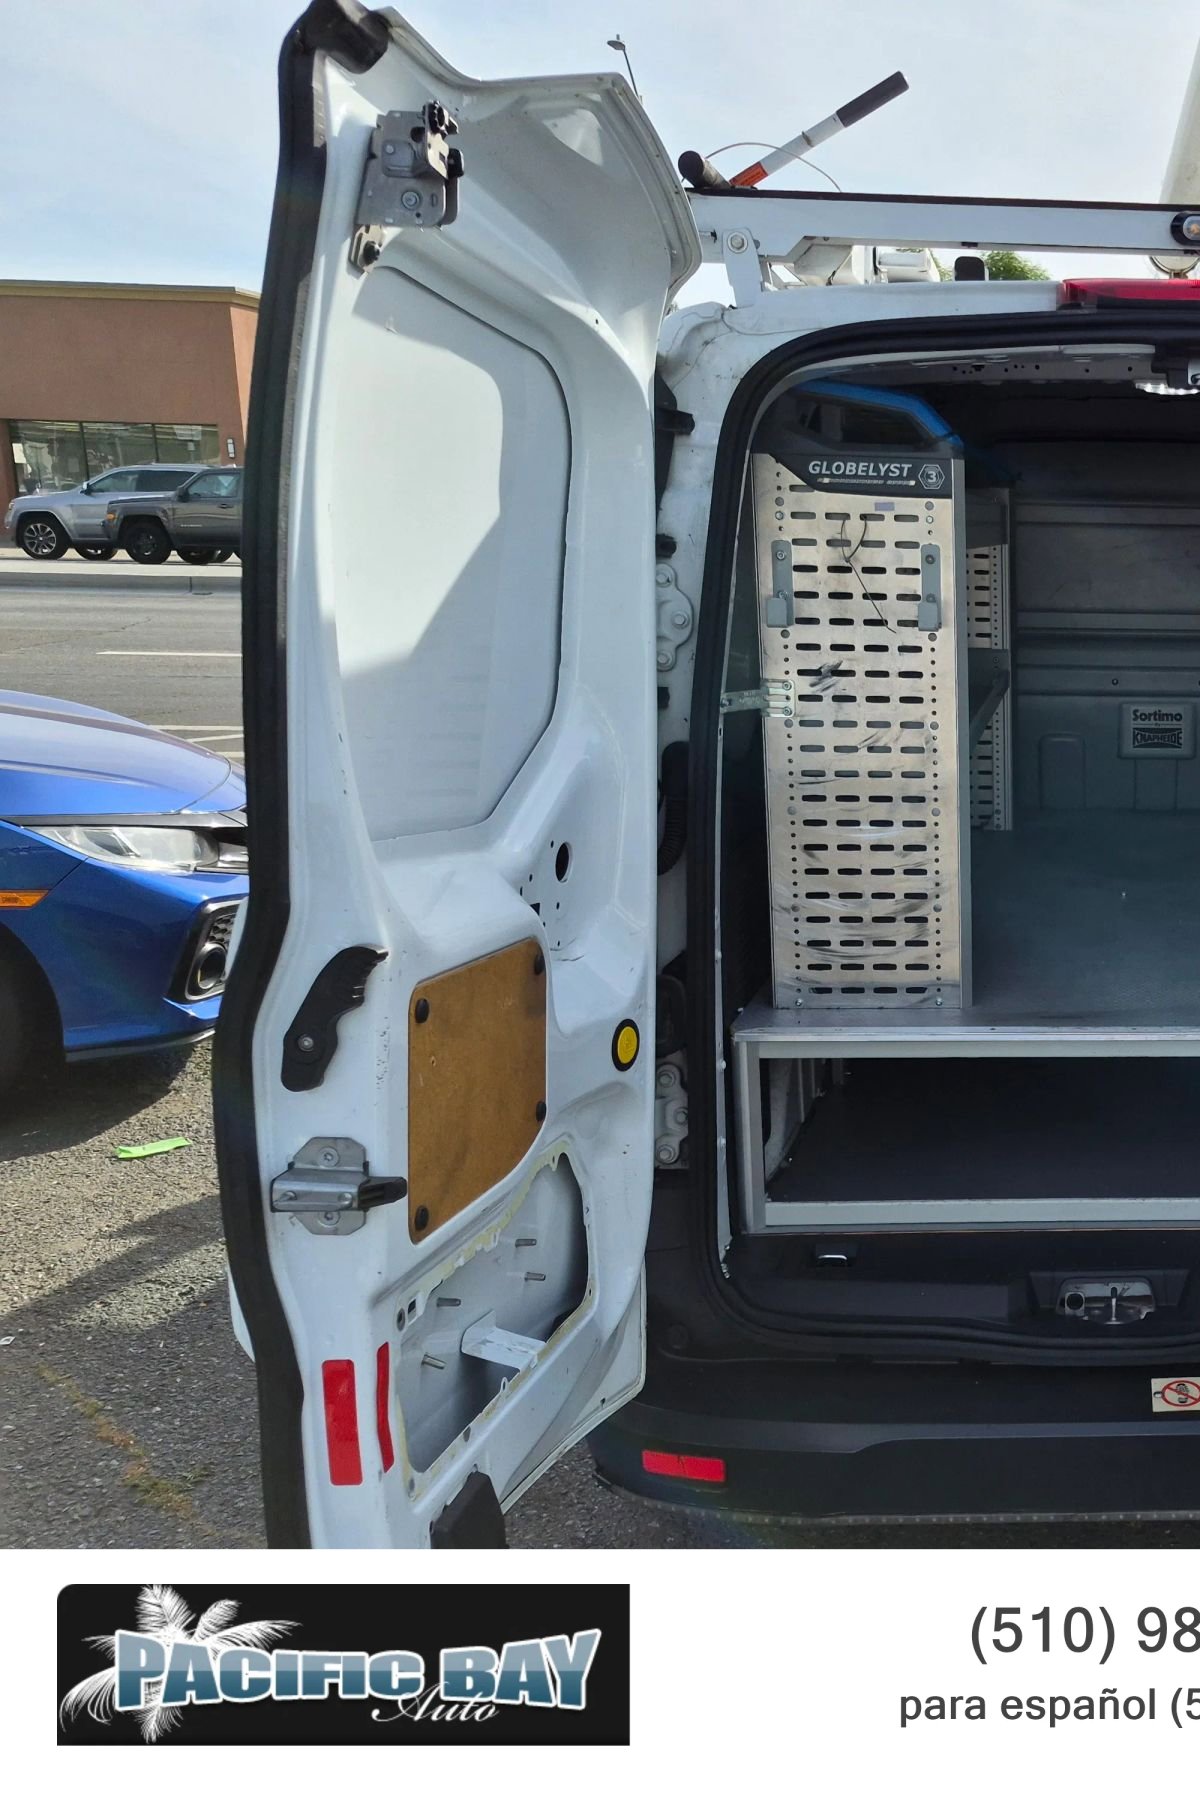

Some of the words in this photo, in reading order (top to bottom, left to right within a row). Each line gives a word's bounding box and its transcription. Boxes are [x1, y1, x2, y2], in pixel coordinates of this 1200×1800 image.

[808, 460, 913, 477] GLOBELYST
[1132, 708, 1183, 722] Sortimo
[1132, 729, 1183, 747] KNAPHEIDE
